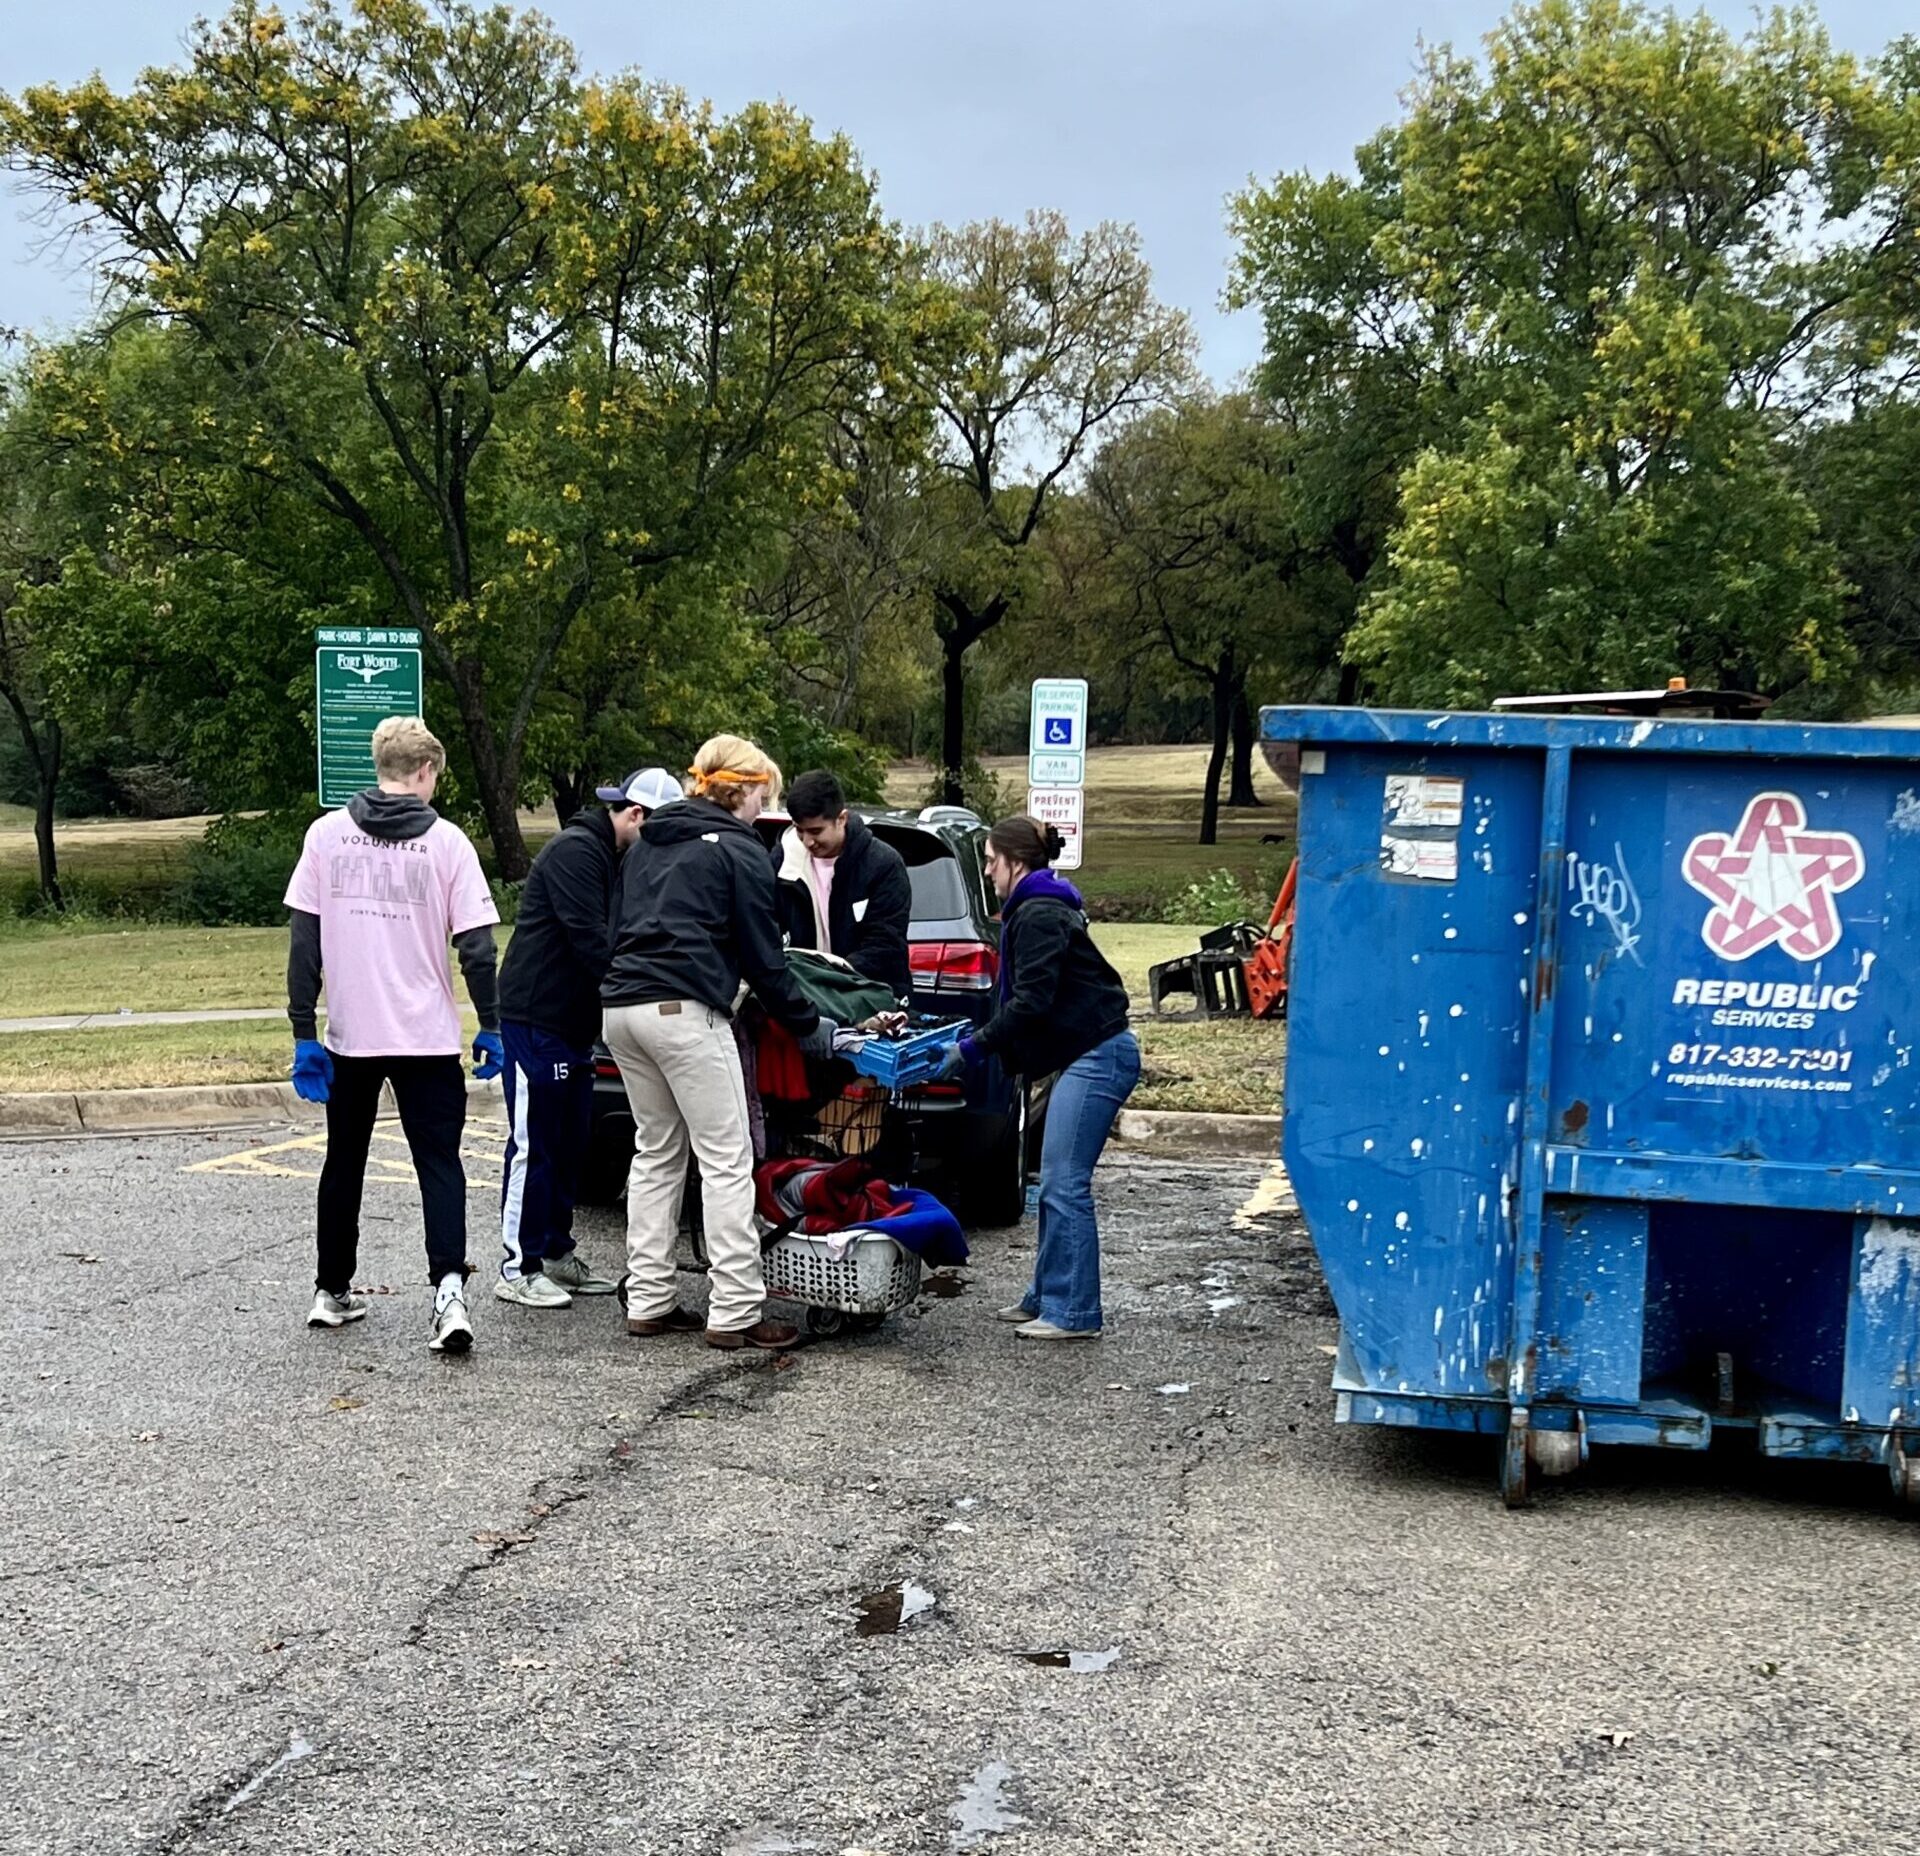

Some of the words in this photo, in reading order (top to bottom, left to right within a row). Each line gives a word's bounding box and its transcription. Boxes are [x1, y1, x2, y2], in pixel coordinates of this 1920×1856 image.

[319, 630, 336, 641] PARK
[367, 631, 387, 644] DAWN
[388, 632, 398, 643] TO
[400, 632, 419, 643] DUSK
[337, 653, 360, 668] FORT
[362, 653, 398, 668] WORTH
[1037, 690, 1082, 700] RESERVED
[1040, 701, 1078, 712] PARKING
[1046, 760, 1068, 769] VAN
[1034, 796, 1076, 806] PREVENT
[1041, 809, 1069, 818] THEFT
[341, 835, 428, 855] VOLUNTEER
[1672, 979, 1859, 1012] REPUBLIC
[1711, 1008, 1816, 1030] SERVICES
[553, 1062, 569, 1080] 15
[1666, 1071, 1853, 1093] republicservices.com
